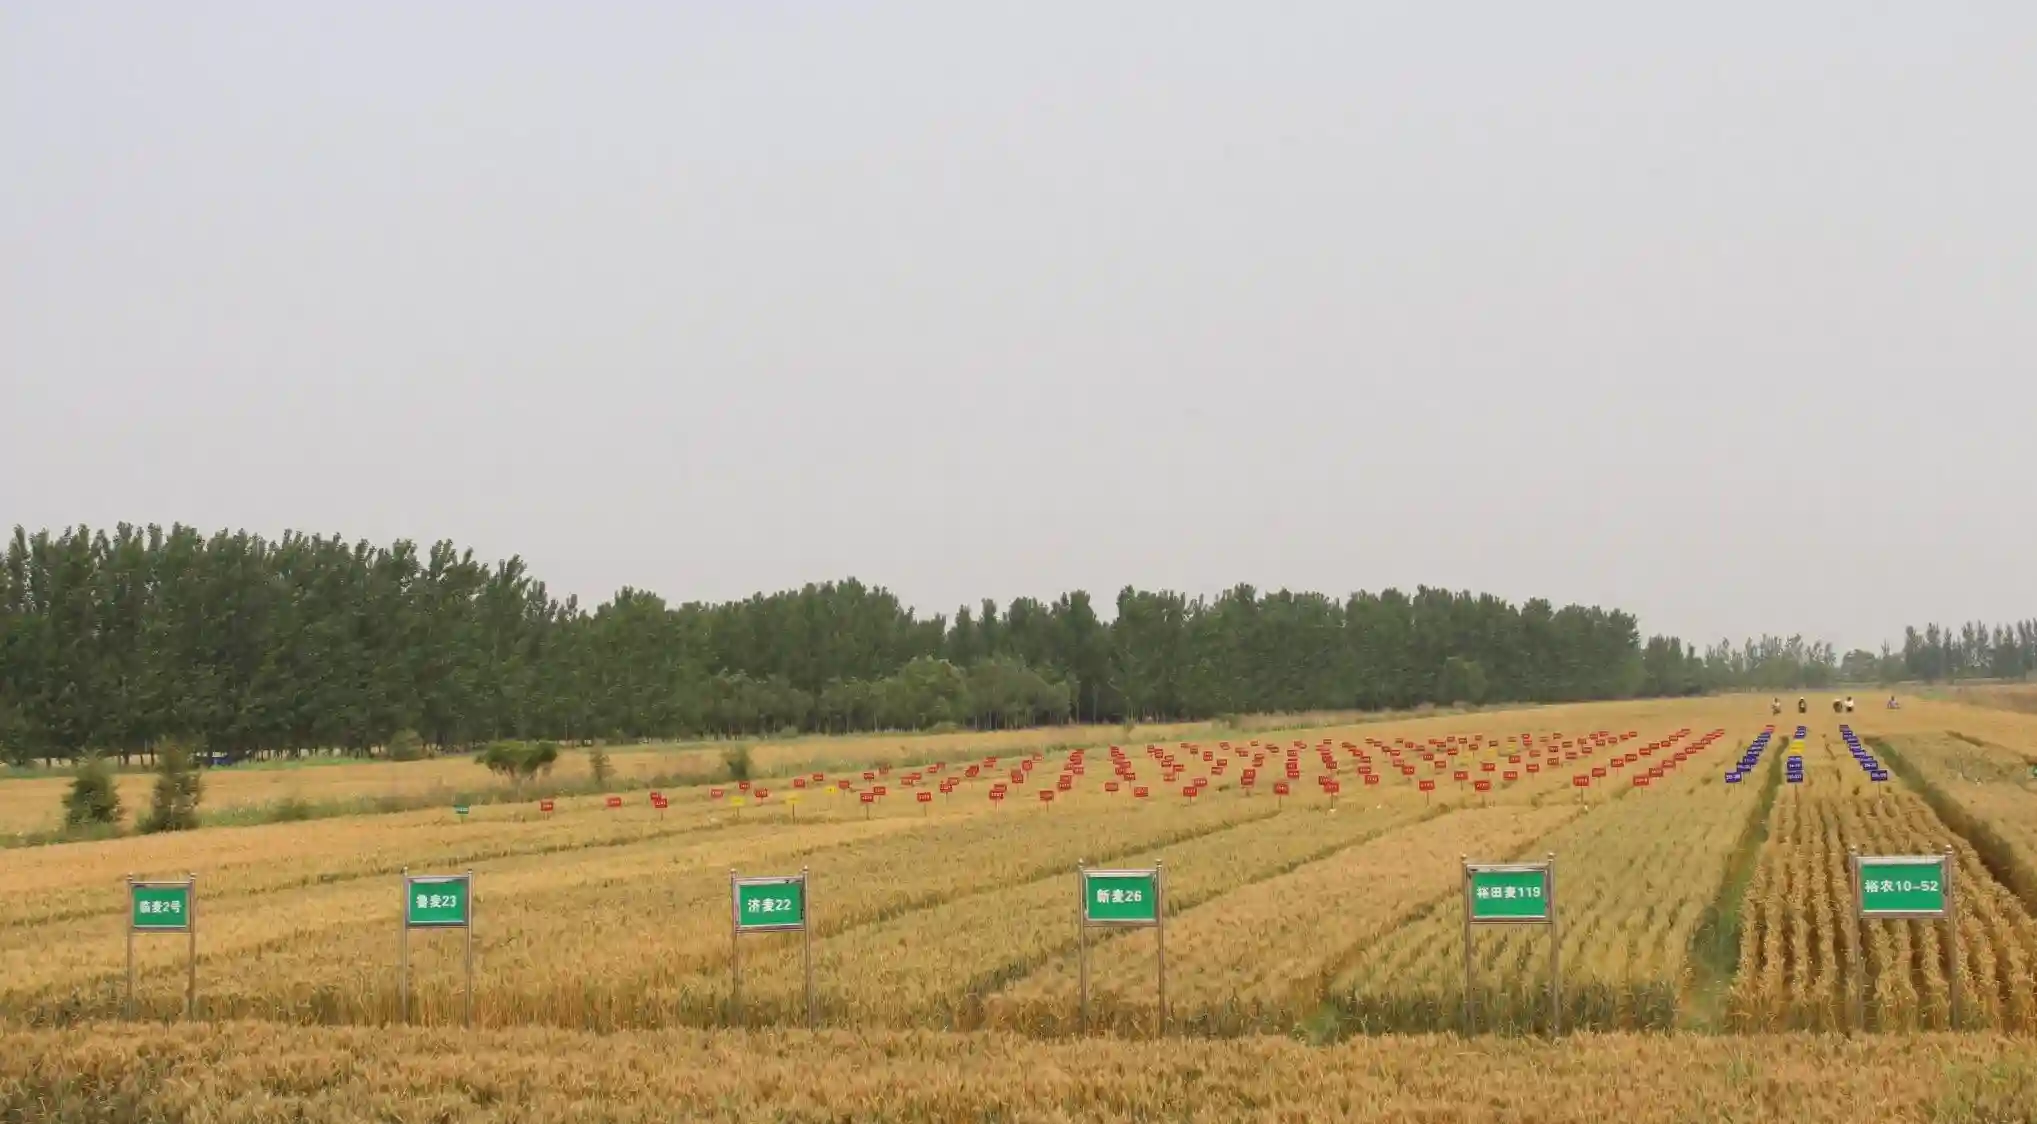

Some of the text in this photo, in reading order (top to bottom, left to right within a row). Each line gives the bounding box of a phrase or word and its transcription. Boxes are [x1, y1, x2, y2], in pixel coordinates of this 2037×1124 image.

[1477, 886, 1541, 899] 裕田麦119
[1864, 879, 1939, 893] 裕农10-52
[415, 894, 457, 909] 鲁麦23
[1096, 888, 1142, 904] 新麦26
[747, 897, 792, 913] 济麦22
